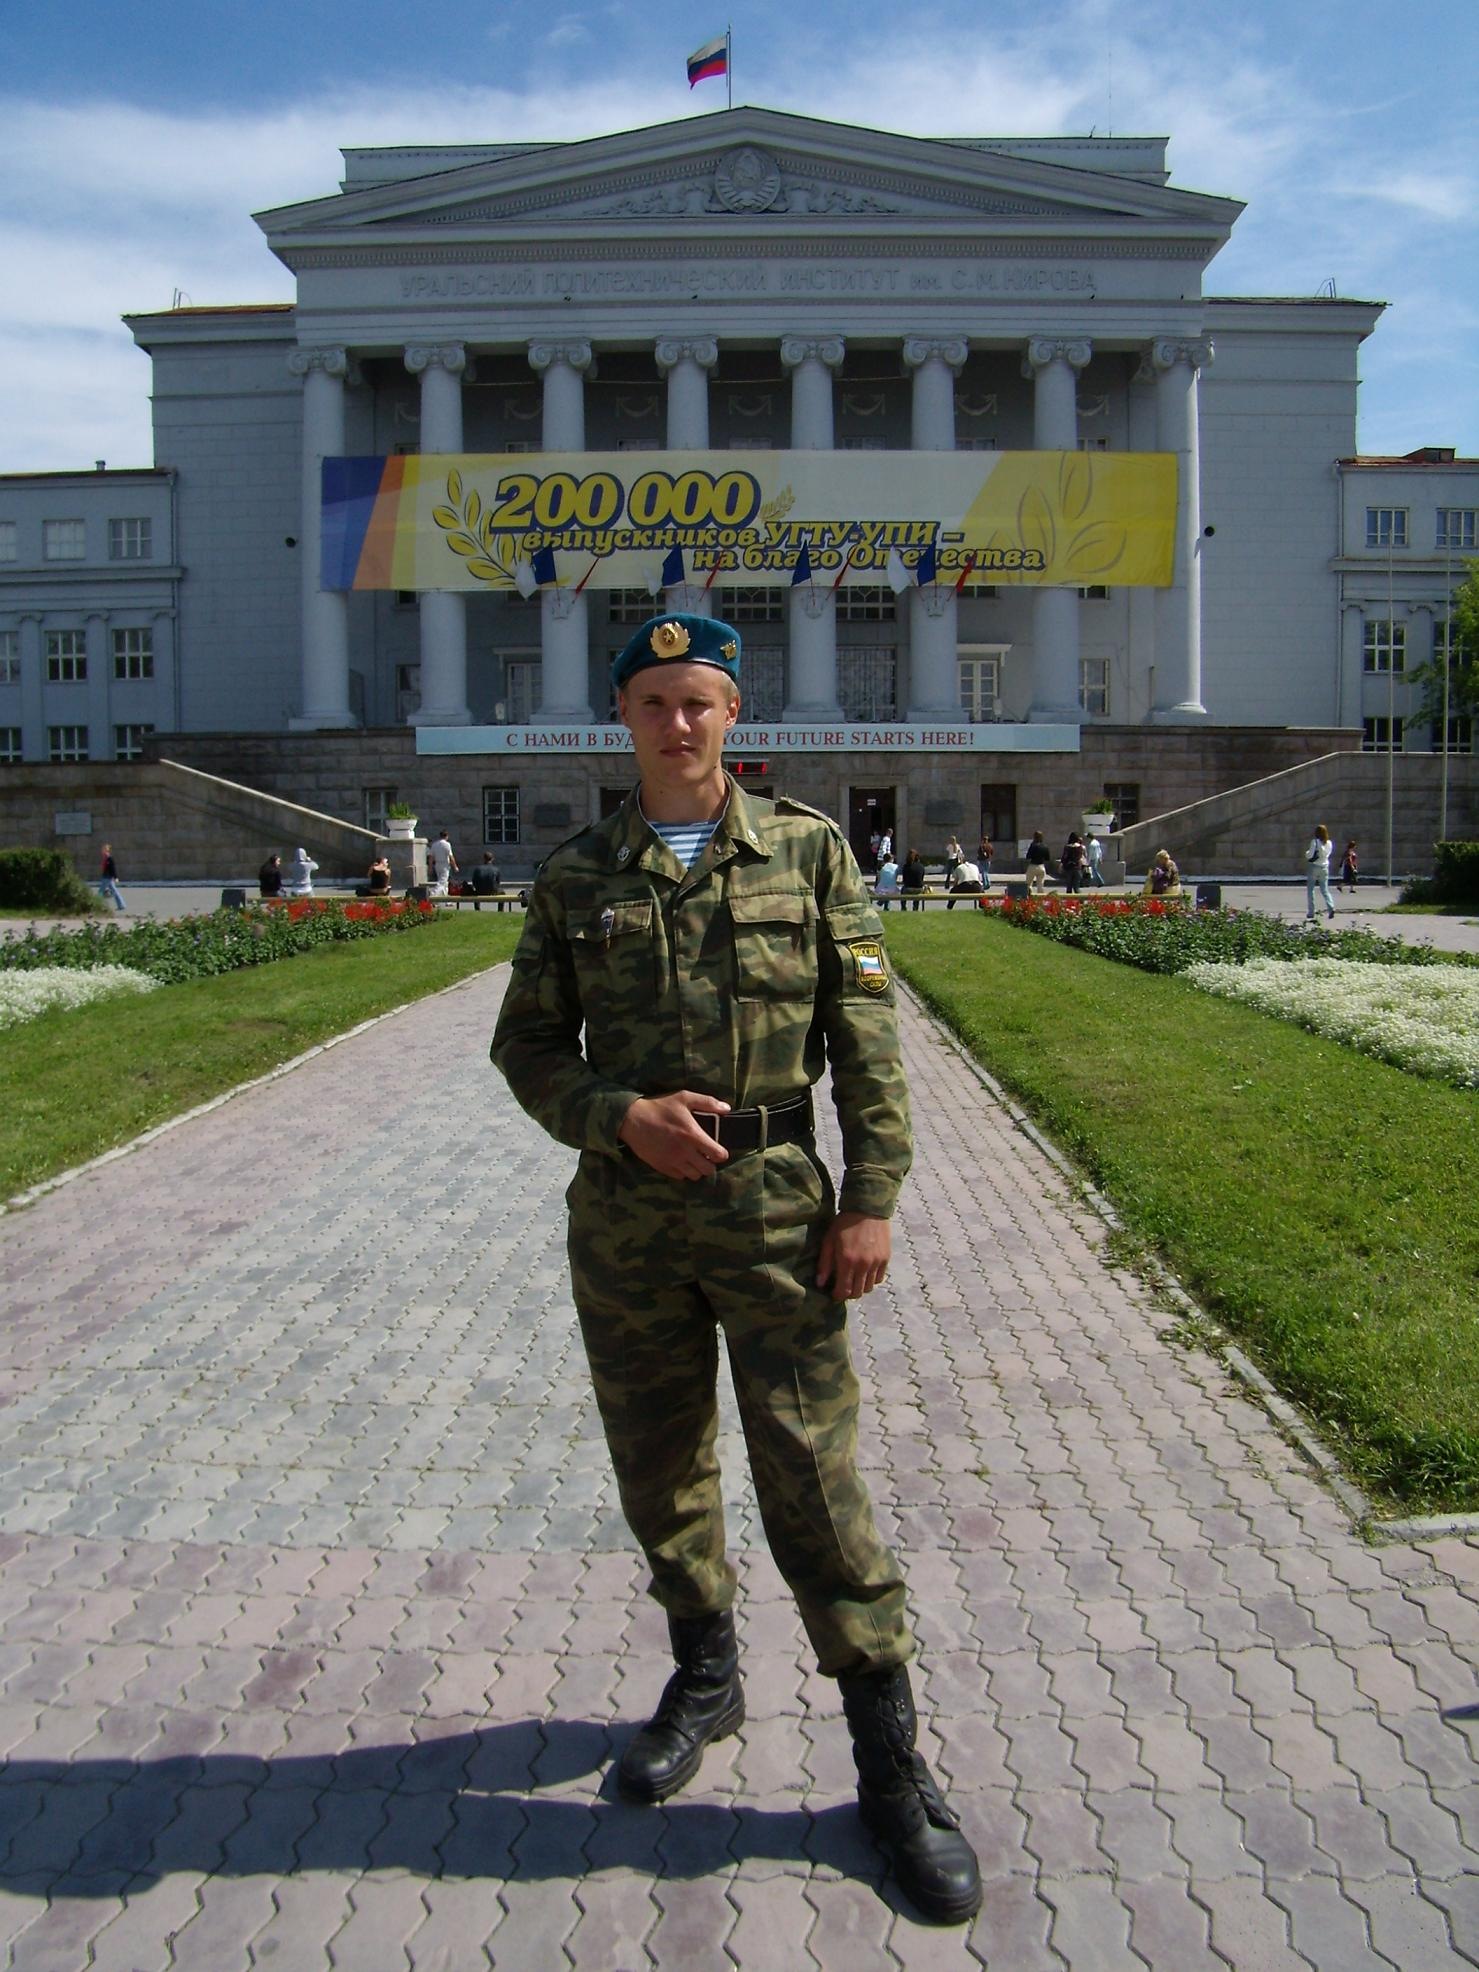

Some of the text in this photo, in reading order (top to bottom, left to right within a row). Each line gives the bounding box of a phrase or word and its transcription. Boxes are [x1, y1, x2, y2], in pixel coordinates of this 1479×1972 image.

[780, 269, 899, 290] ИНСТИТУТ
[523, 528, 757, 557] выпускников
[760, 521, 941, 549] УГТУ-УПИ
[693, 543, 1046, 571] на благо Отеества
[506, 732, 518, 746] С
[524, 732, 580, 747] НАМИ
[586, 732, 598, 746] В
[723, 731, 974, 746] YOUR FUTURE STARTS HERE!
